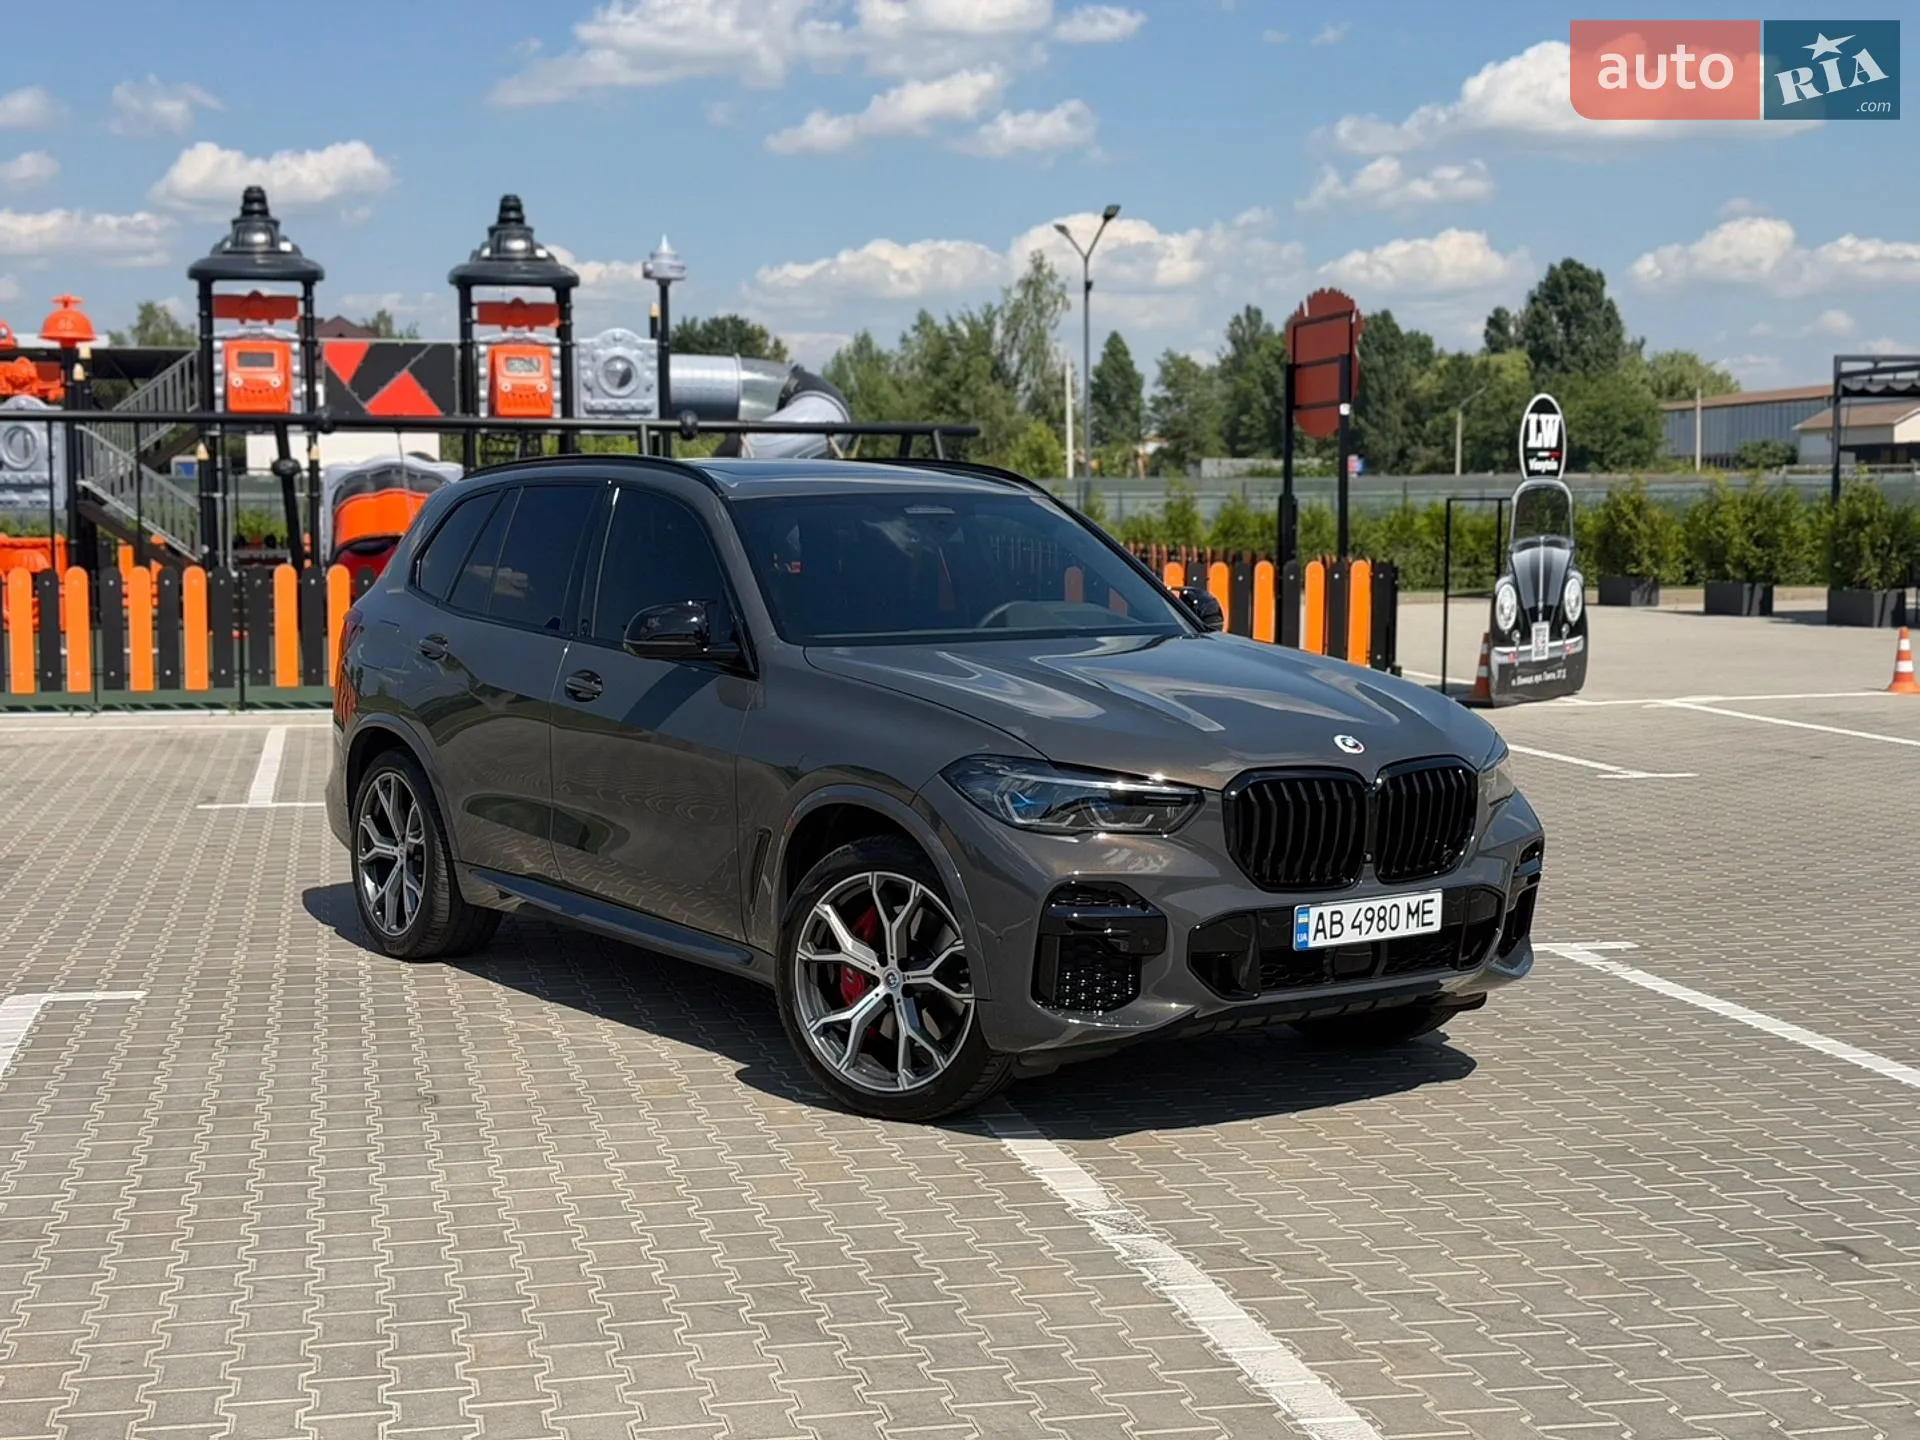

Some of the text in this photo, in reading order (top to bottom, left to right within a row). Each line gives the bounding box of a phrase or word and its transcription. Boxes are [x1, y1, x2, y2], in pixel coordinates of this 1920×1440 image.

[1527, 413, 1561, 448] LW
[1312, 898, 1435, 942] AB 4980 ME
[1296, 933, 1308, 943] UA
